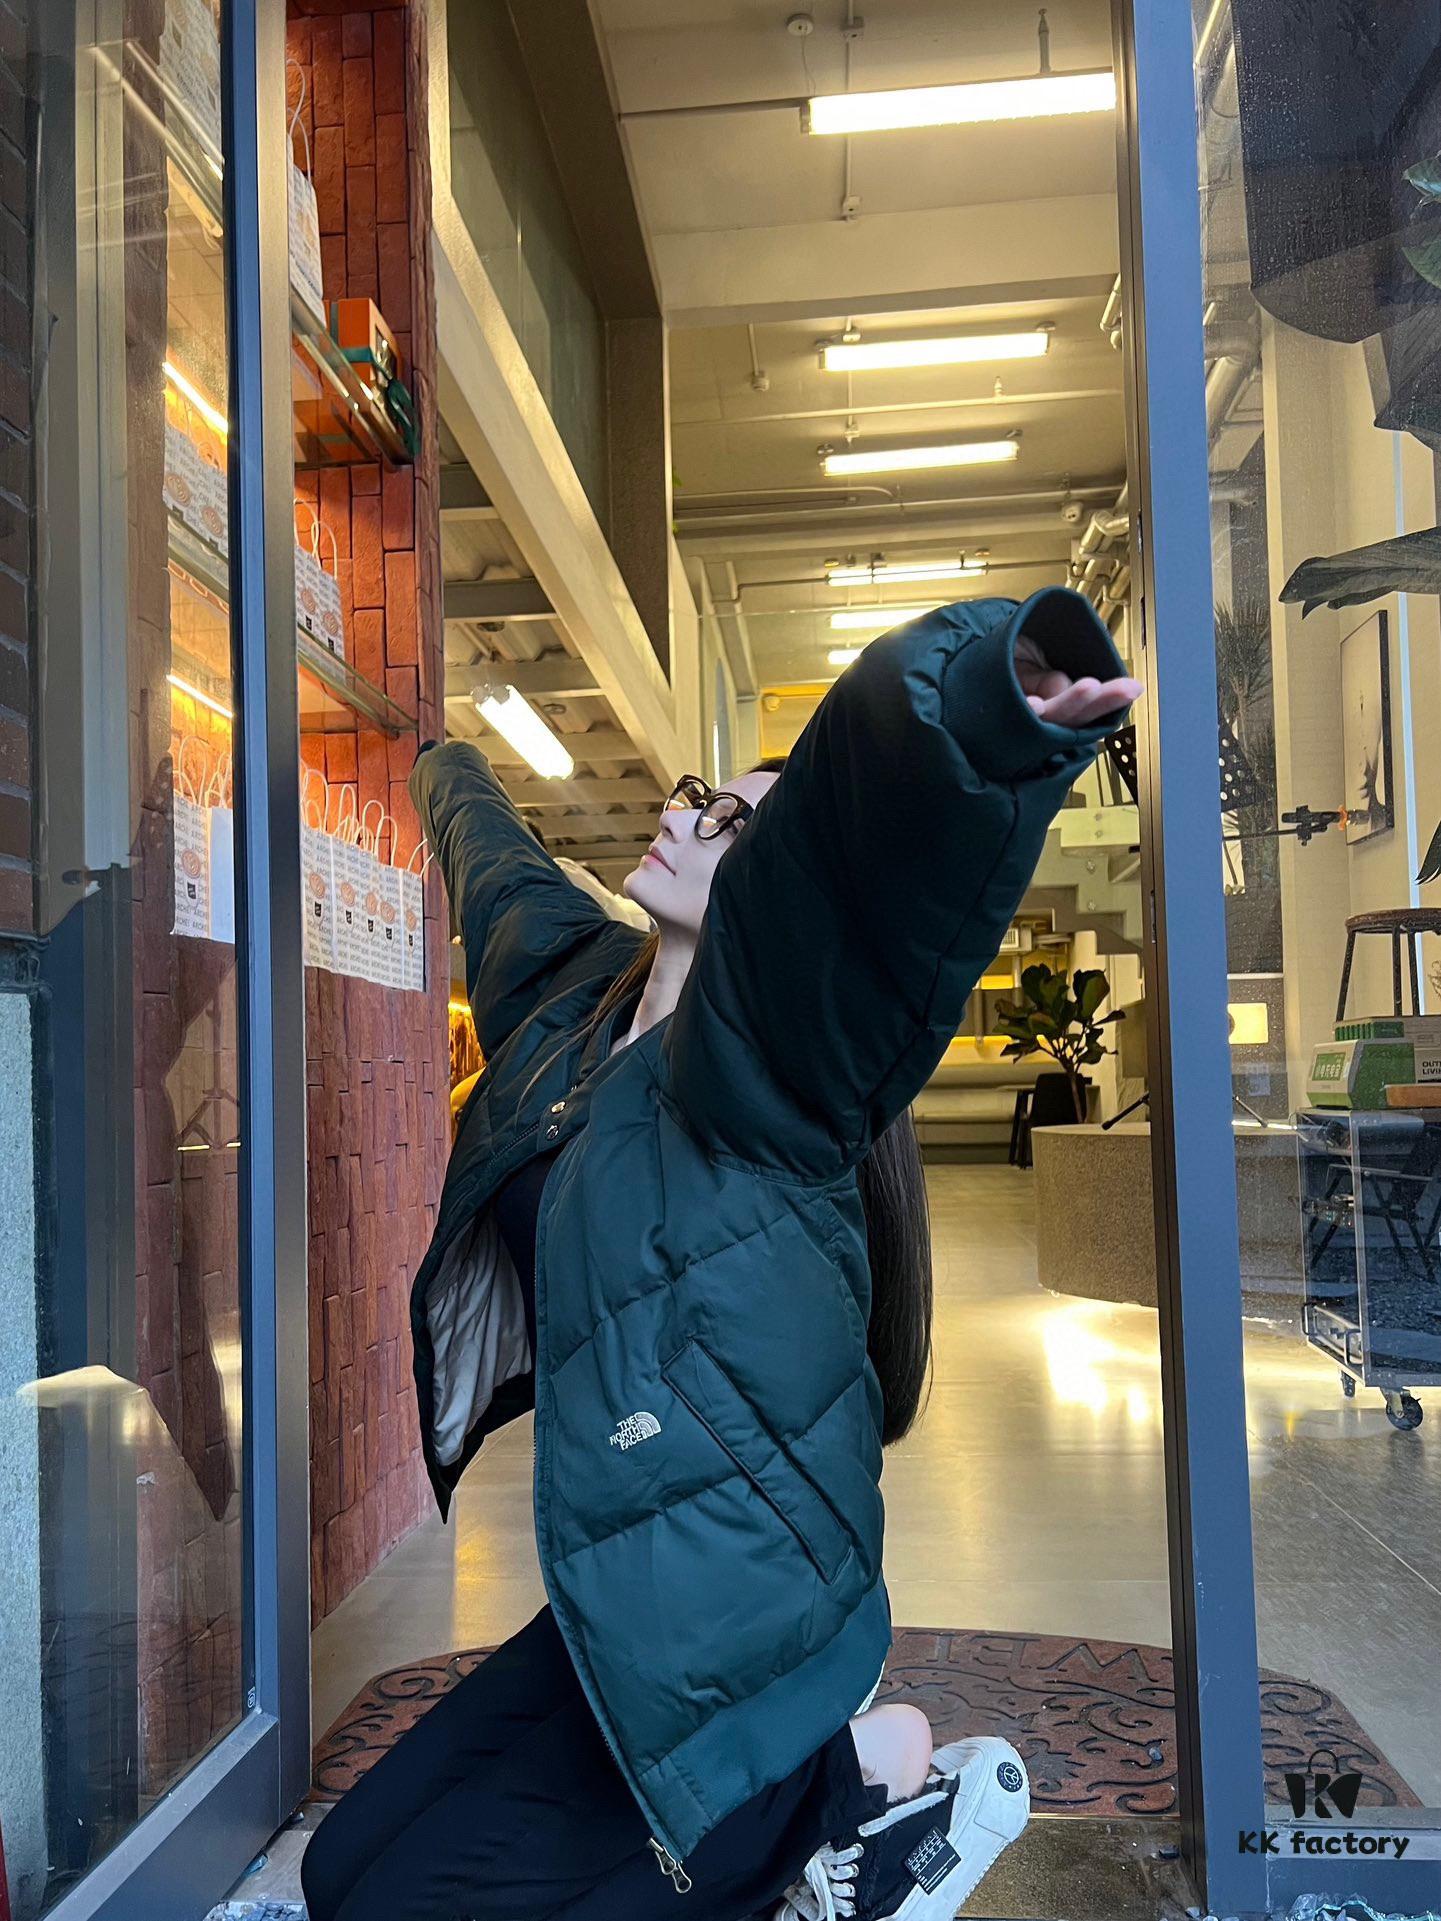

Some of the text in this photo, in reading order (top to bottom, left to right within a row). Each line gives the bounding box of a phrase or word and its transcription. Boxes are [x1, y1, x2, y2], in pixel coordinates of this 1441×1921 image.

[616, 1415, 637, 1431] THE
[609, 1423, 641, 1446] NORTH
[619, 1433, 643, 1451] FACE
